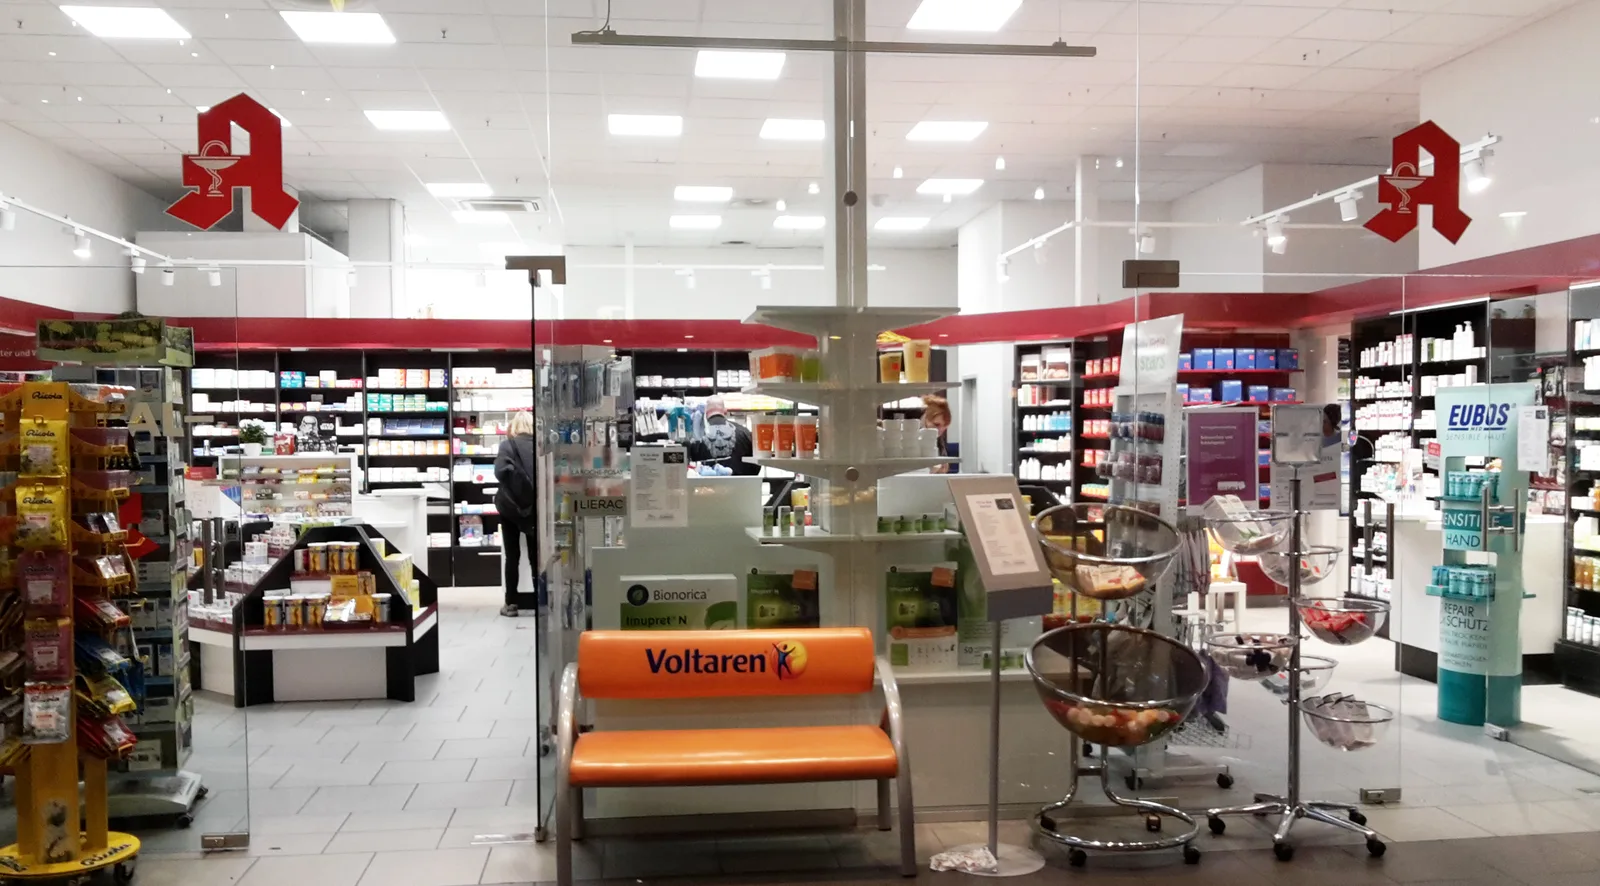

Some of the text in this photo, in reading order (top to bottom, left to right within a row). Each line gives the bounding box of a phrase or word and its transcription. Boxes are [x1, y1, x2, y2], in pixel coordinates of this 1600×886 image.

[32, 391, 63, 400] Ricola
[1448, 403, 1510, 426] EUBOS
[26, 429, 55, 437] Ricola
[580, 500, 623, 509] LIERAC
[1446, 534, 1480, 548] HAND
[653, 589, 707, 601] Bionorica
[678, 616, 687, 625] N
[645, 648, 766, 674] Voltaren
